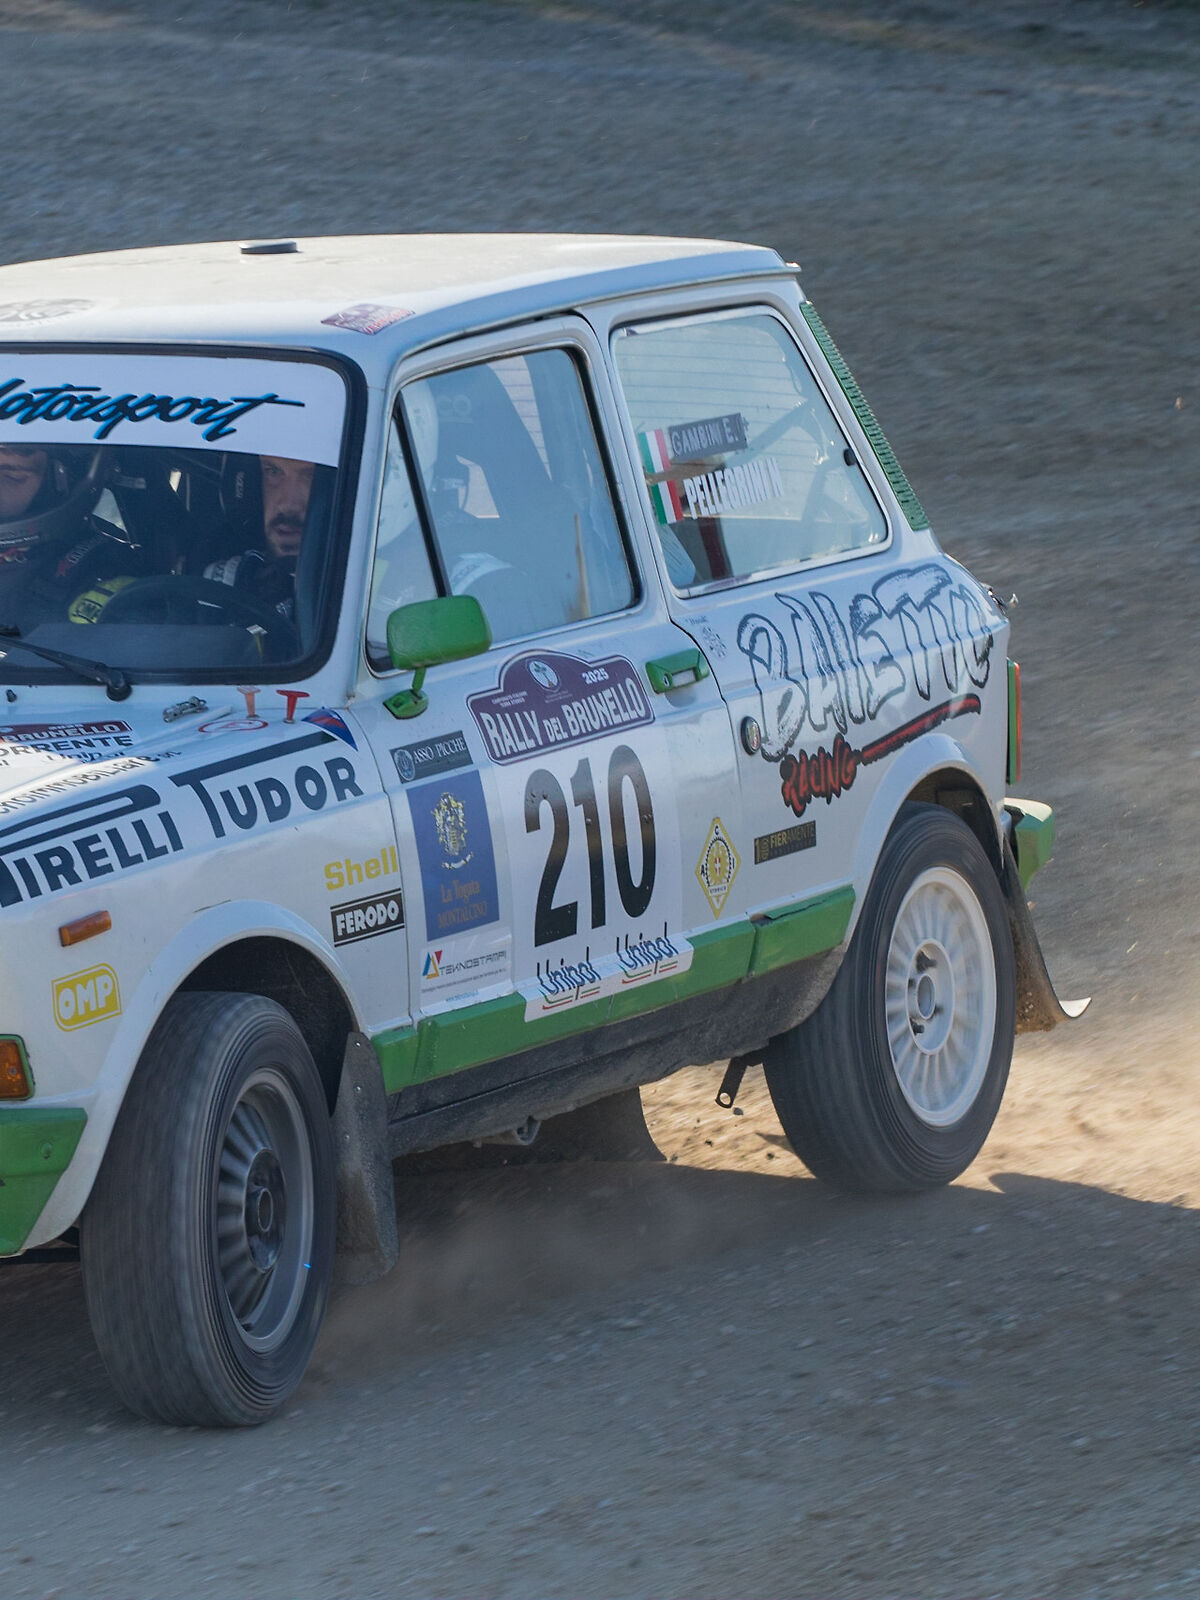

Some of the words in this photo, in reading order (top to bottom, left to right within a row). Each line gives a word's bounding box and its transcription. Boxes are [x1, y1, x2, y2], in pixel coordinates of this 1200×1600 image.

[582, 667, 609, 684] 2025
[0, 723, 121, 743] BRUNELLO
[479, 711, 544, 758] RALLY
[542, 716, 569, 743] DEL
[561, 677, 647, 737] BRUNELLO
[412, 745, 434, 764] ASSO
[436, 736, 467, 759] PICCHE
[169, 731, 364, 839] TUDOR
[324, 844, 399, 891] Shell
[524, 744, 657, 947] 210
[335, 899, 400, 936] FERODO
[536, 946, 602, 1000] Unipol
[617, 921, 680, 975] Unipol
[57, 971, 114, 1021] OMP
